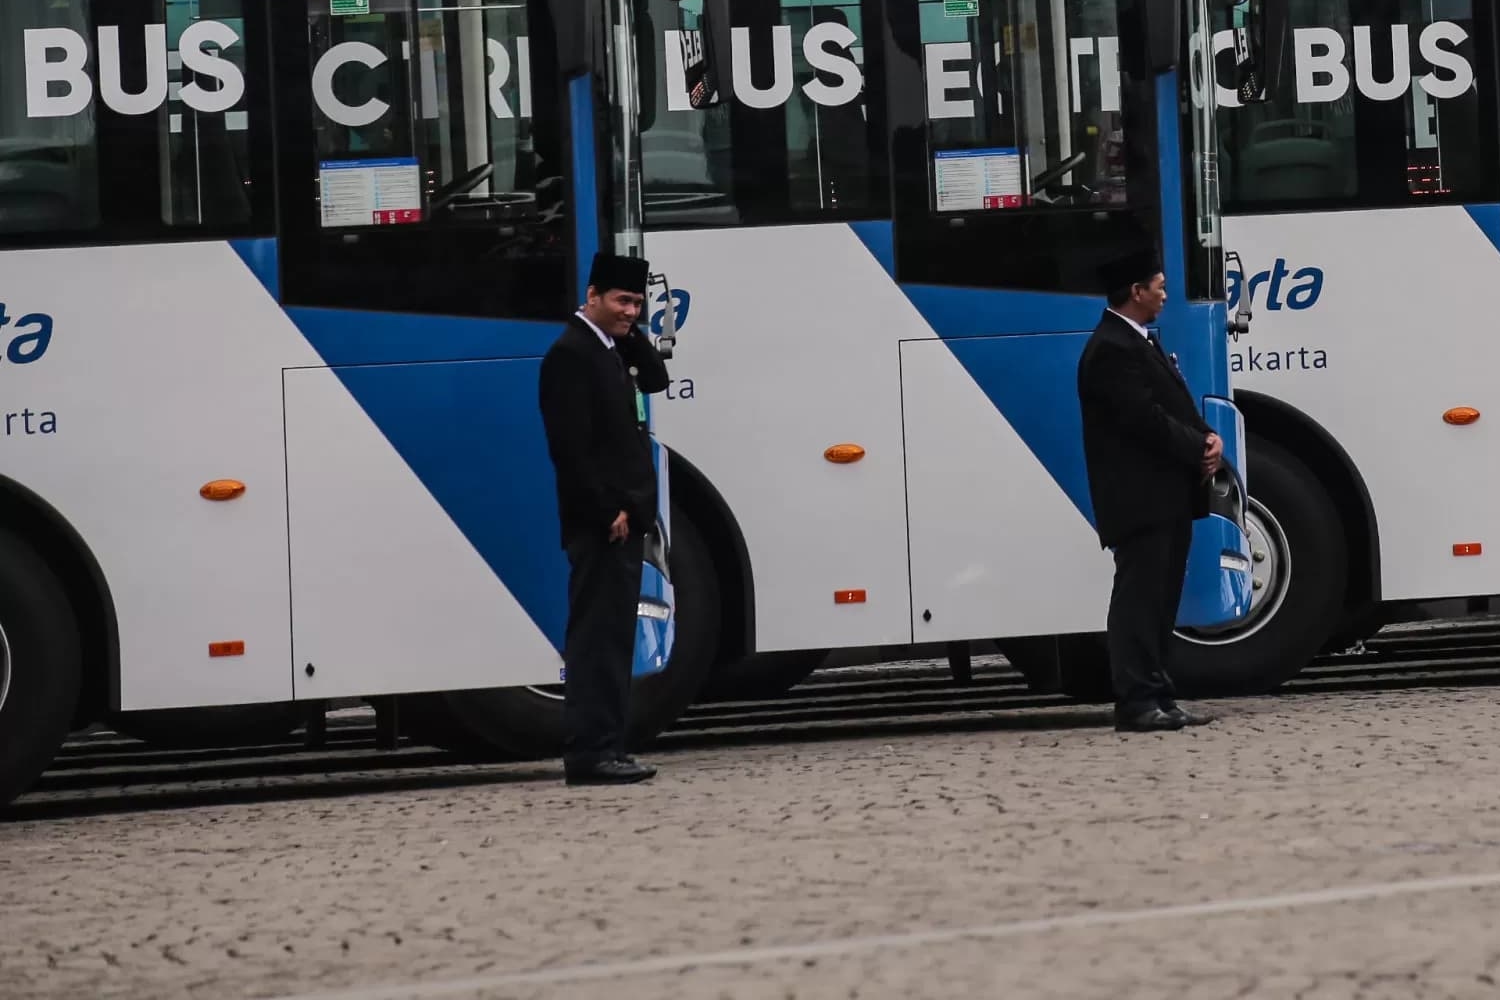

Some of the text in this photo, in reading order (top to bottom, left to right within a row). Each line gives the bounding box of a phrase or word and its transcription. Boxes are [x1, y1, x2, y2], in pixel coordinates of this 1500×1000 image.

[24, 20, 245, 118] BUS
[1294, 21, 1473, 103] BUS
[5, 408, 57, 435] rta
